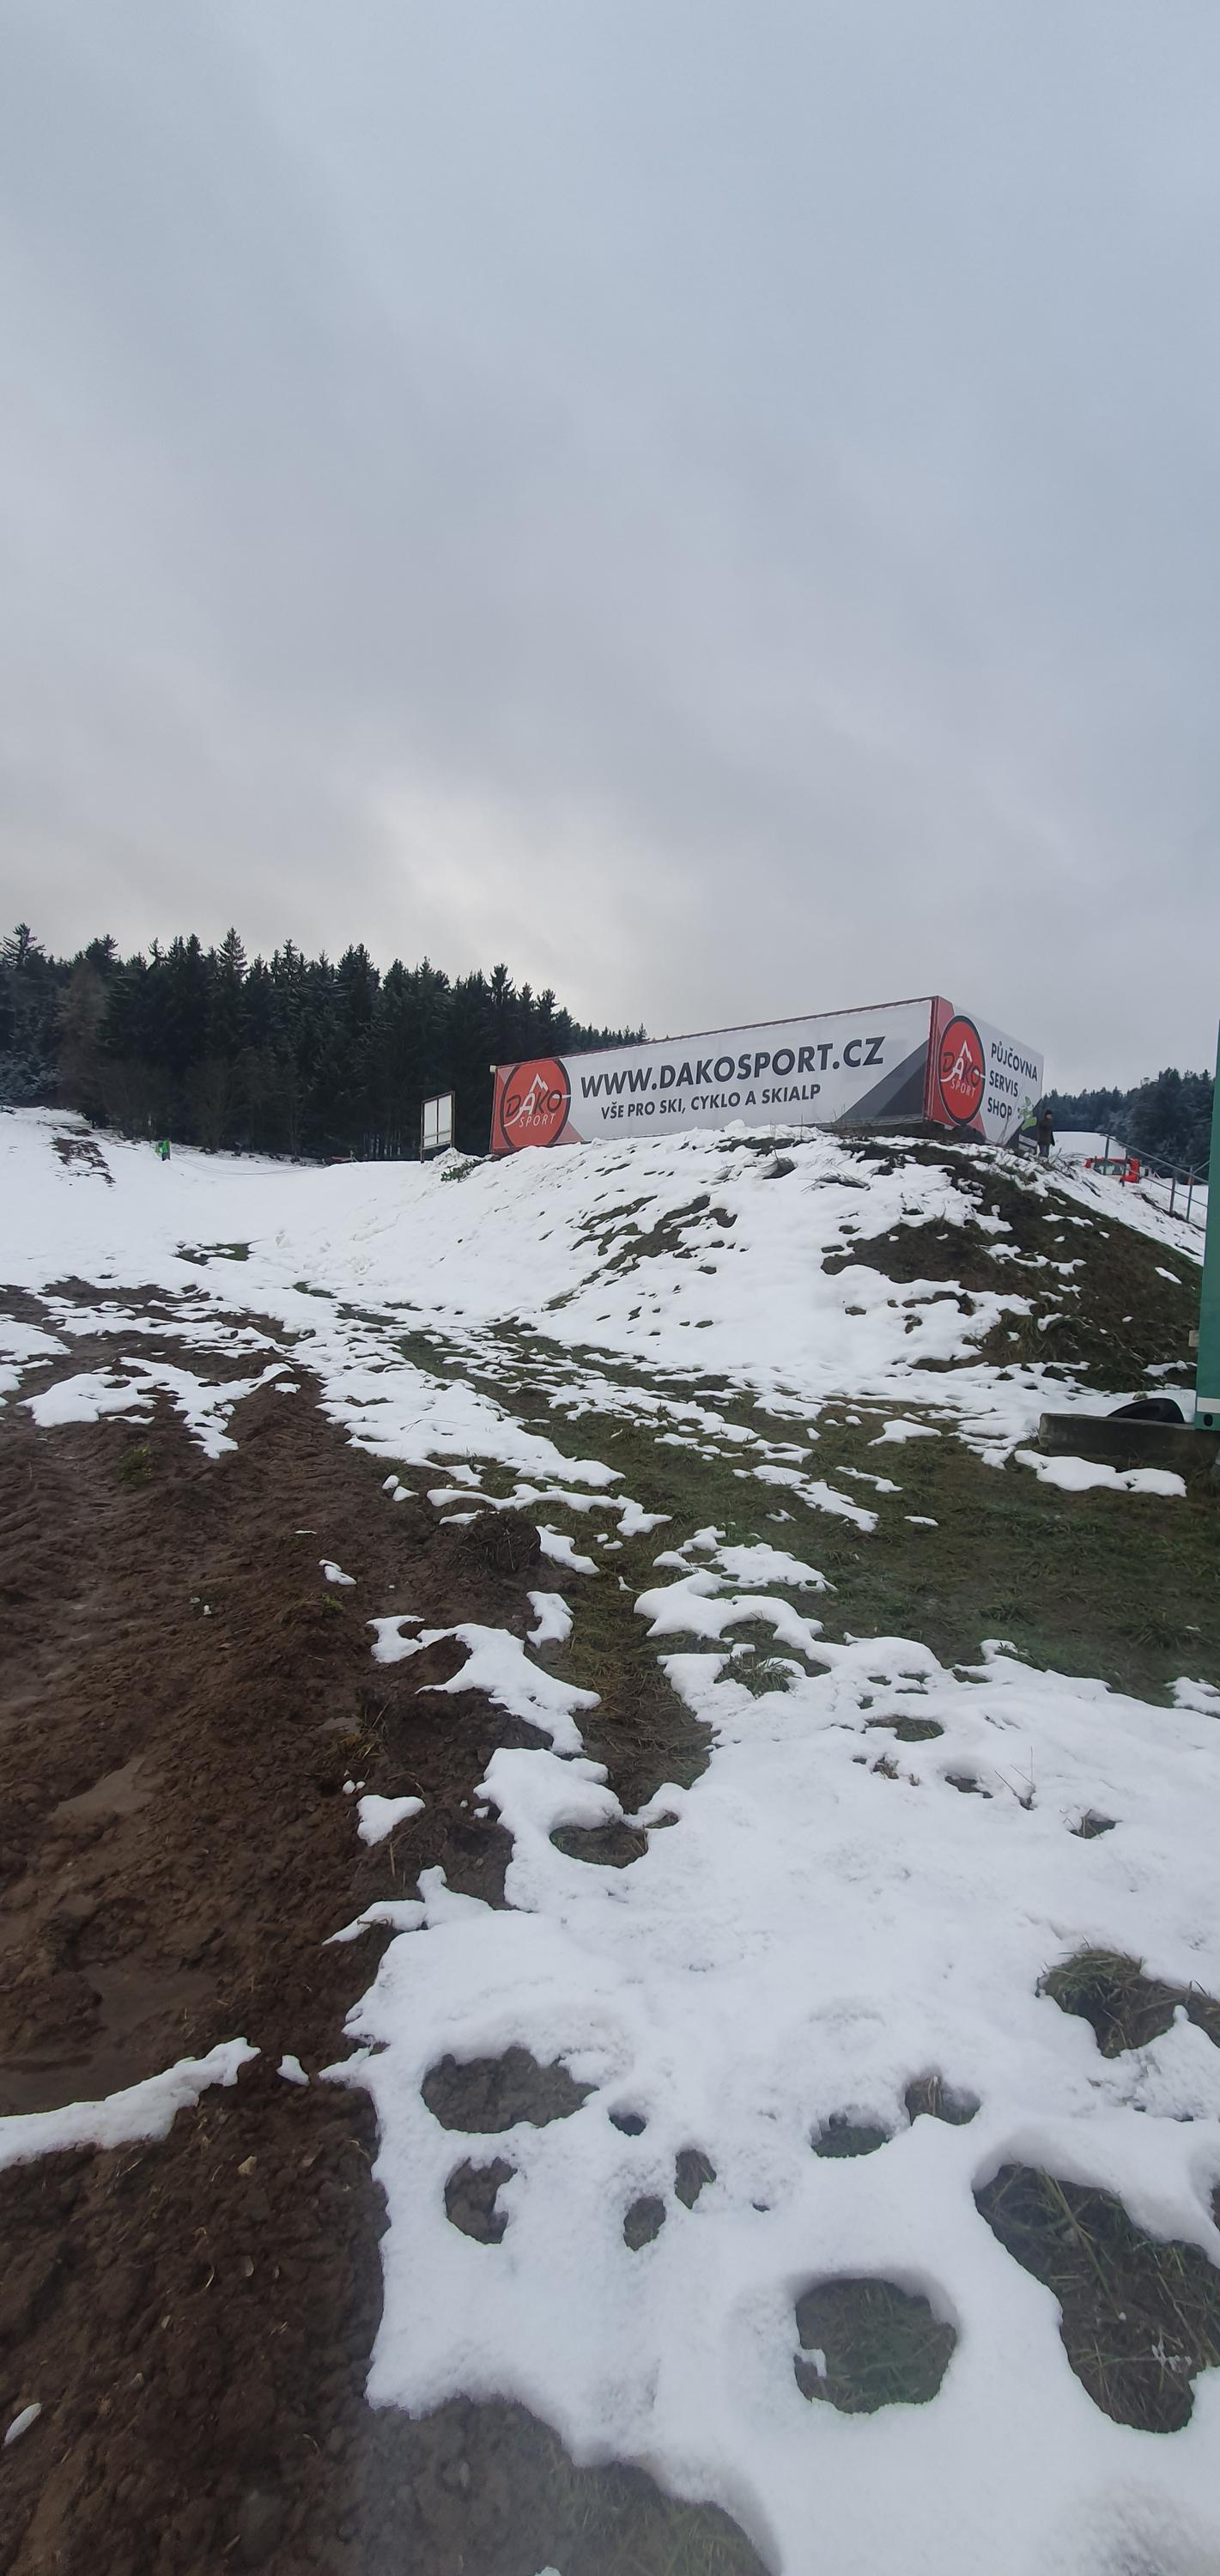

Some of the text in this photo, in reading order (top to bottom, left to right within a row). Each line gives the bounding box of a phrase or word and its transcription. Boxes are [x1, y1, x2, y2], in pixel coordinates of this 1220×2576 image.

[580, 1036, 886, 1098] WWW.DAKOSPORT.CZ
[991, 1041, 1038, 1082] PŮJČOVNA
[950, 1078, 976, 1098] SPORT
[989, 1070, 1018, 1097] SERVIS
[506, 1086, 562, 1120] DAKO
[601, 1084, 821, 1120] VŠE PRO SKI, CYKLO A SKIALP
[987, 1097, 1013, 1121] SHOP
[519, 1113, 557, 1127] SPORT
